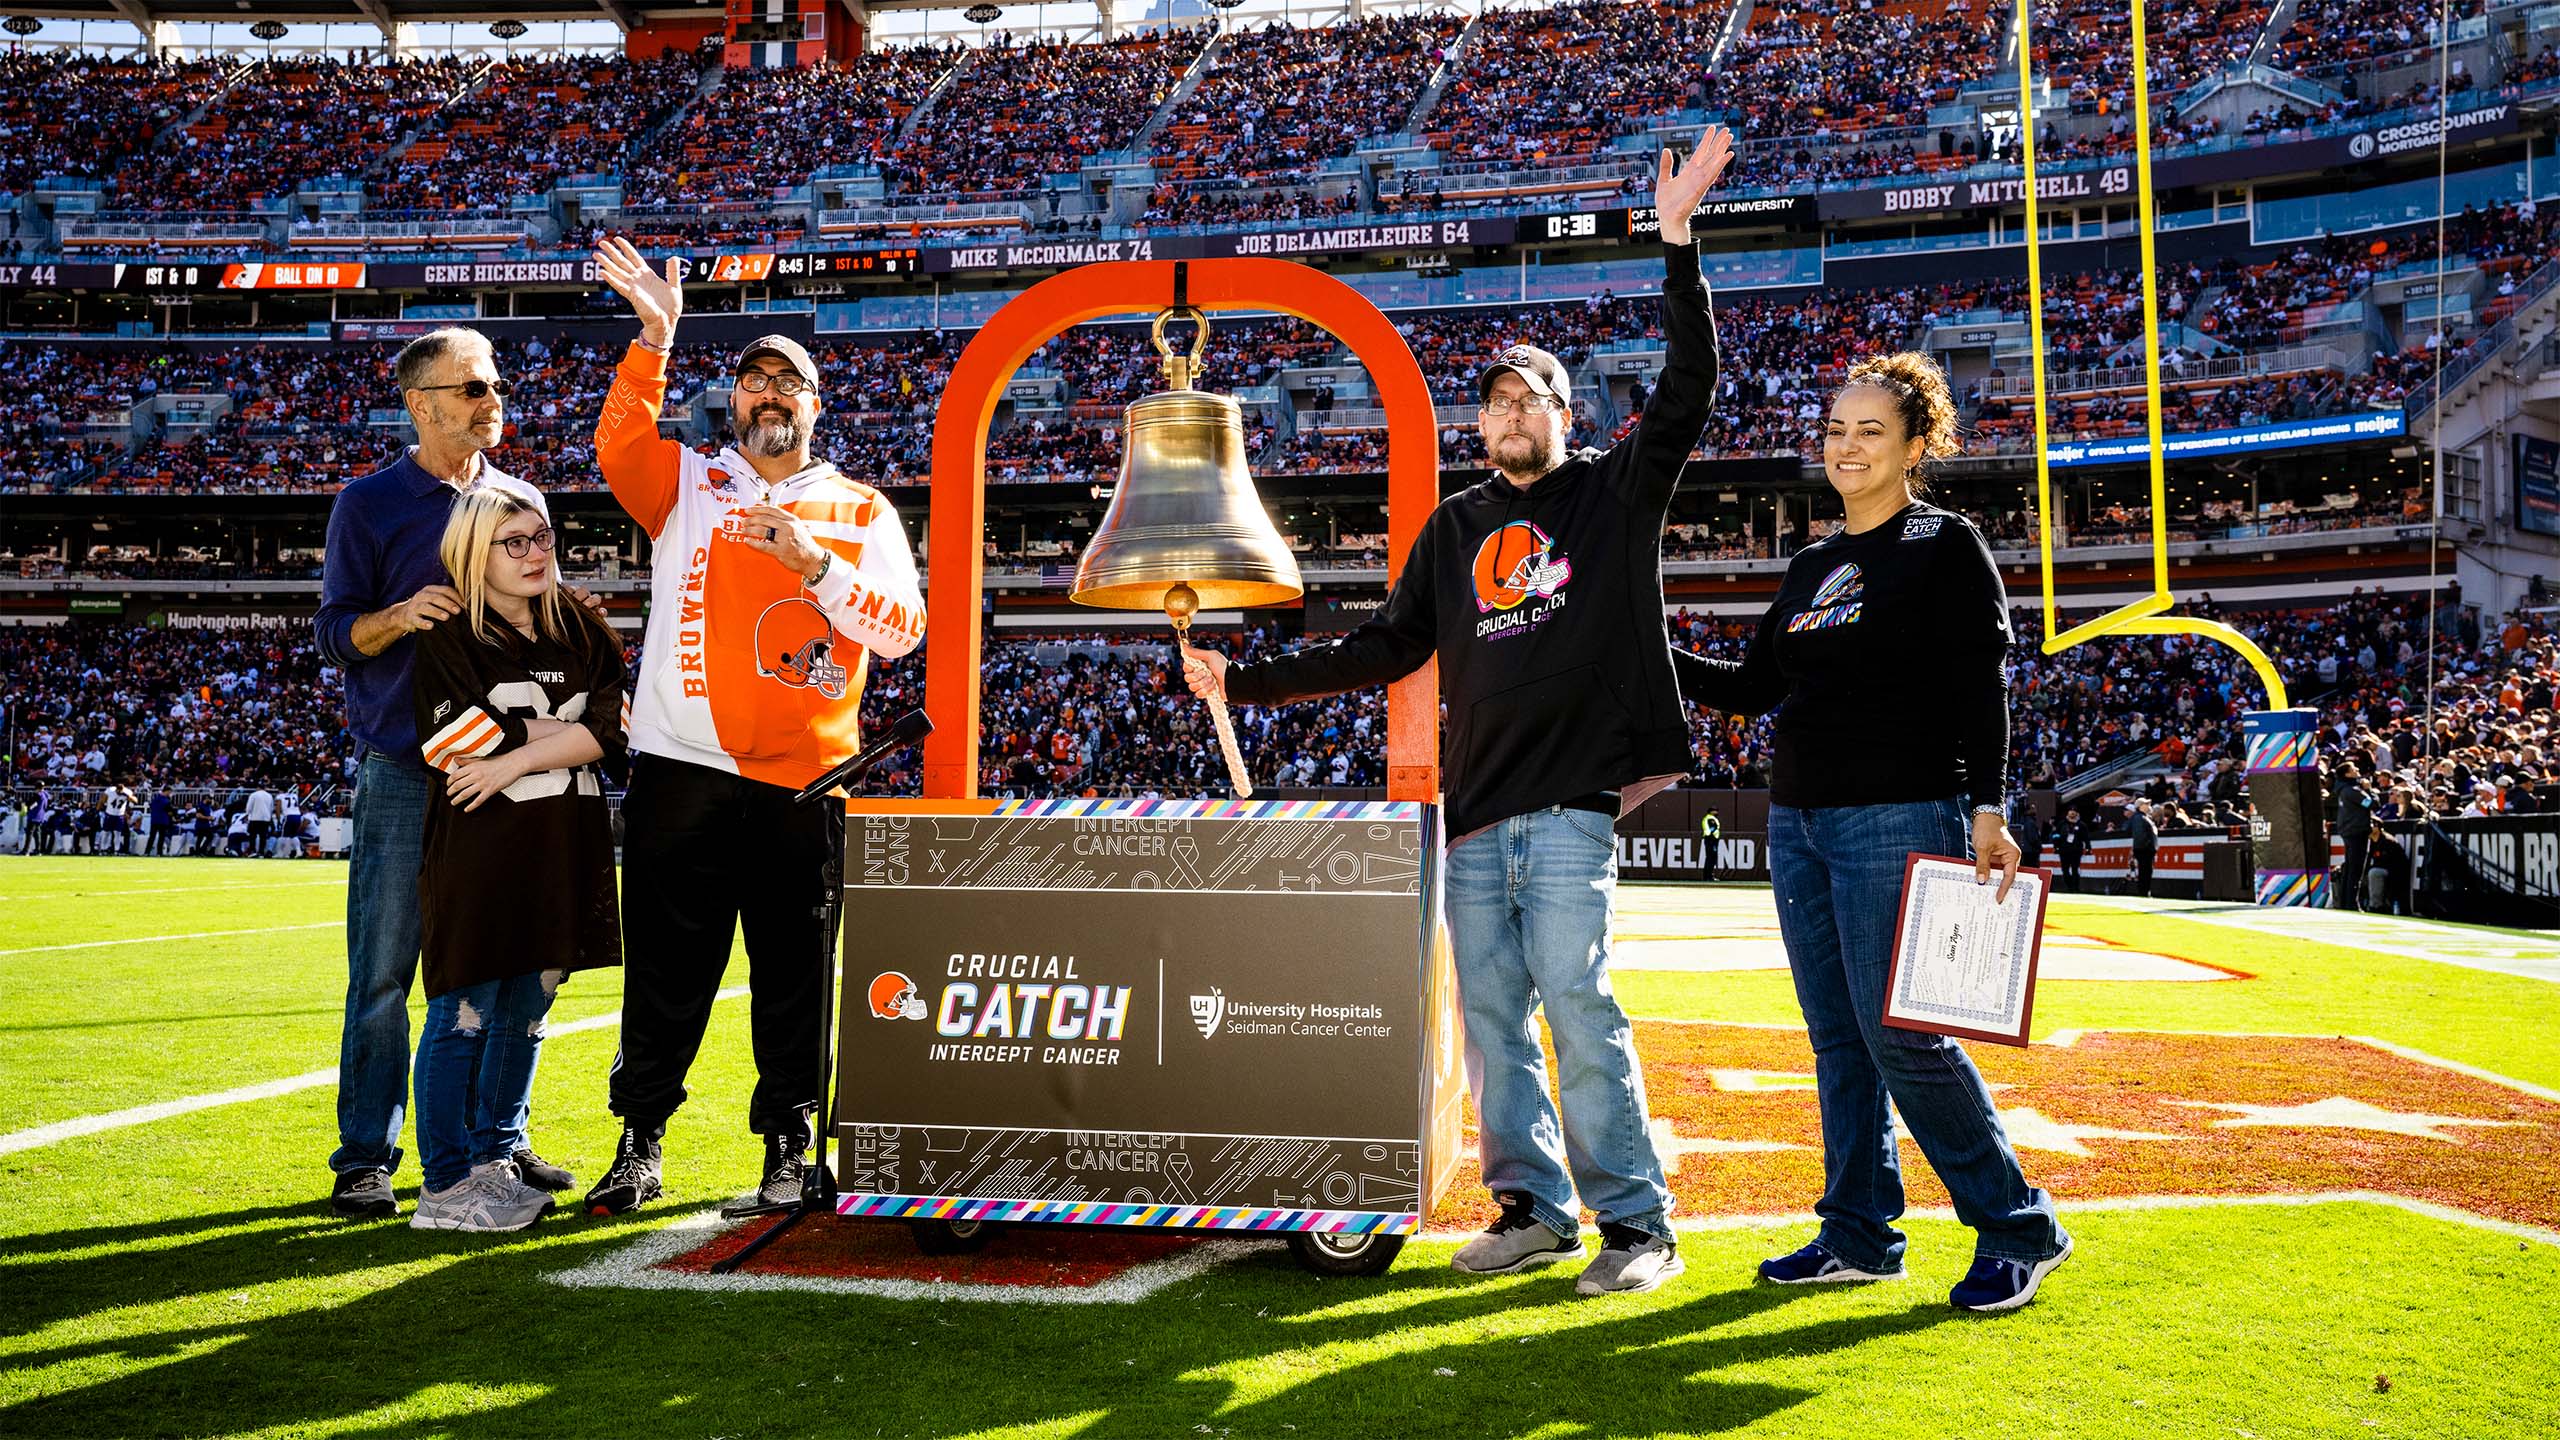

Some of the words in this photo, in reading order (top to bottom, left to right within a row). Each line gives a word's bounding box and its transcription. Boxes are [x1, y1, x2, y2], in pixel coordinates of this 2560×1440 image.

[2377, 104, 2509, 143] CROSSCOUNTRY
[1884, 185, 1955, 211] BOBBY
[2100, 168, 2129, 194] 49
[1631, 209, 1647, 221] OF
[1713, 203, 1727, 214] AT
[1729, 199, 1795, 213] UNIVERSITY
[1547, 213, 1596, 238] 0:38
[1235, 234, 1272, 255] JOE
[1442, 221, 1469, 244] 64
[835, 257, 851, 270] 1ST
[862, 257, 873, 269] 10
[951, 248, 998, 268] MIKE
[1007, 243, 1121, 266] McCORMACK
[1128, 240, 1153, 262] 74
[425, 264, 470, 283] GENE
[474, 263, 573, 282] HICKERSON
[754, 260, 761, 273] 0
[778, 258, 804, 274] 8:45
[815, 259, 827, 271] 25
[886, 260, 896, 272] 10
[908, 259, 914, 272] 1
[31, 265, 57, 286] 44
[169, 267, 179, 285] &
[275, 266, 302, 285] BALL
[306, 266, 323, 285] ON
[327, 266, 339, 285] 10
[2047, 446, 2084, 462] meijer
[2088, 446, 2126, 457] OFFICIAL
[2169, 436, 2229, 451] SUPERCENTER
[2242, 434, 2259, 444] THE
[2260, 427, 2310, 442] CLEVELAND
[2311, 424, 2351, 437] BROWNS
[2354, 416, 2400, 434] meijer
[697, 483, 740, 504] BRWNS
[1903, 522, 1942, 534] CATCH
[1906, 516, 1943, 526] CRUCIAL
[168, 612, 249, 633] Huntington
[251, 613, 287, 630] Bank
[679, 547, 709, 698] BROWNS
[1476, 609, 1528, 637] CRUCIAL
[1787, 602, 1863, 632] BROWNS
[1487, 625, 1528, 642] INTERCEPT
[1074, 818, 1192, 833] INTERCEPT
[1073, 835, 1166, 856] CANCER
[1950, 922, 1962, 944] Ayers
[1946, 944, 1957, 962] Sean
[947, 953, 1079, 979] CRUCIAL
[936, 982, 1132, 1041] CATCH
[1227, 1002, 1305, 1020] University
[1311, 1004, 1382, 1021] Hospitals
[1227, 1020, 1286, 1035] Seidman
[1290, 1022, 1339, 1036] Cancer
[1344, 1023, 1392, 1037] Center
[929, 1044, 1033, 1063] INTERCEPT
[1042, 1046, 1120, 1065] CANCER
[1066, 1132, 1185, 1149] INTERCEPT
[1065, 1149, 1159, 1172] CANCER
